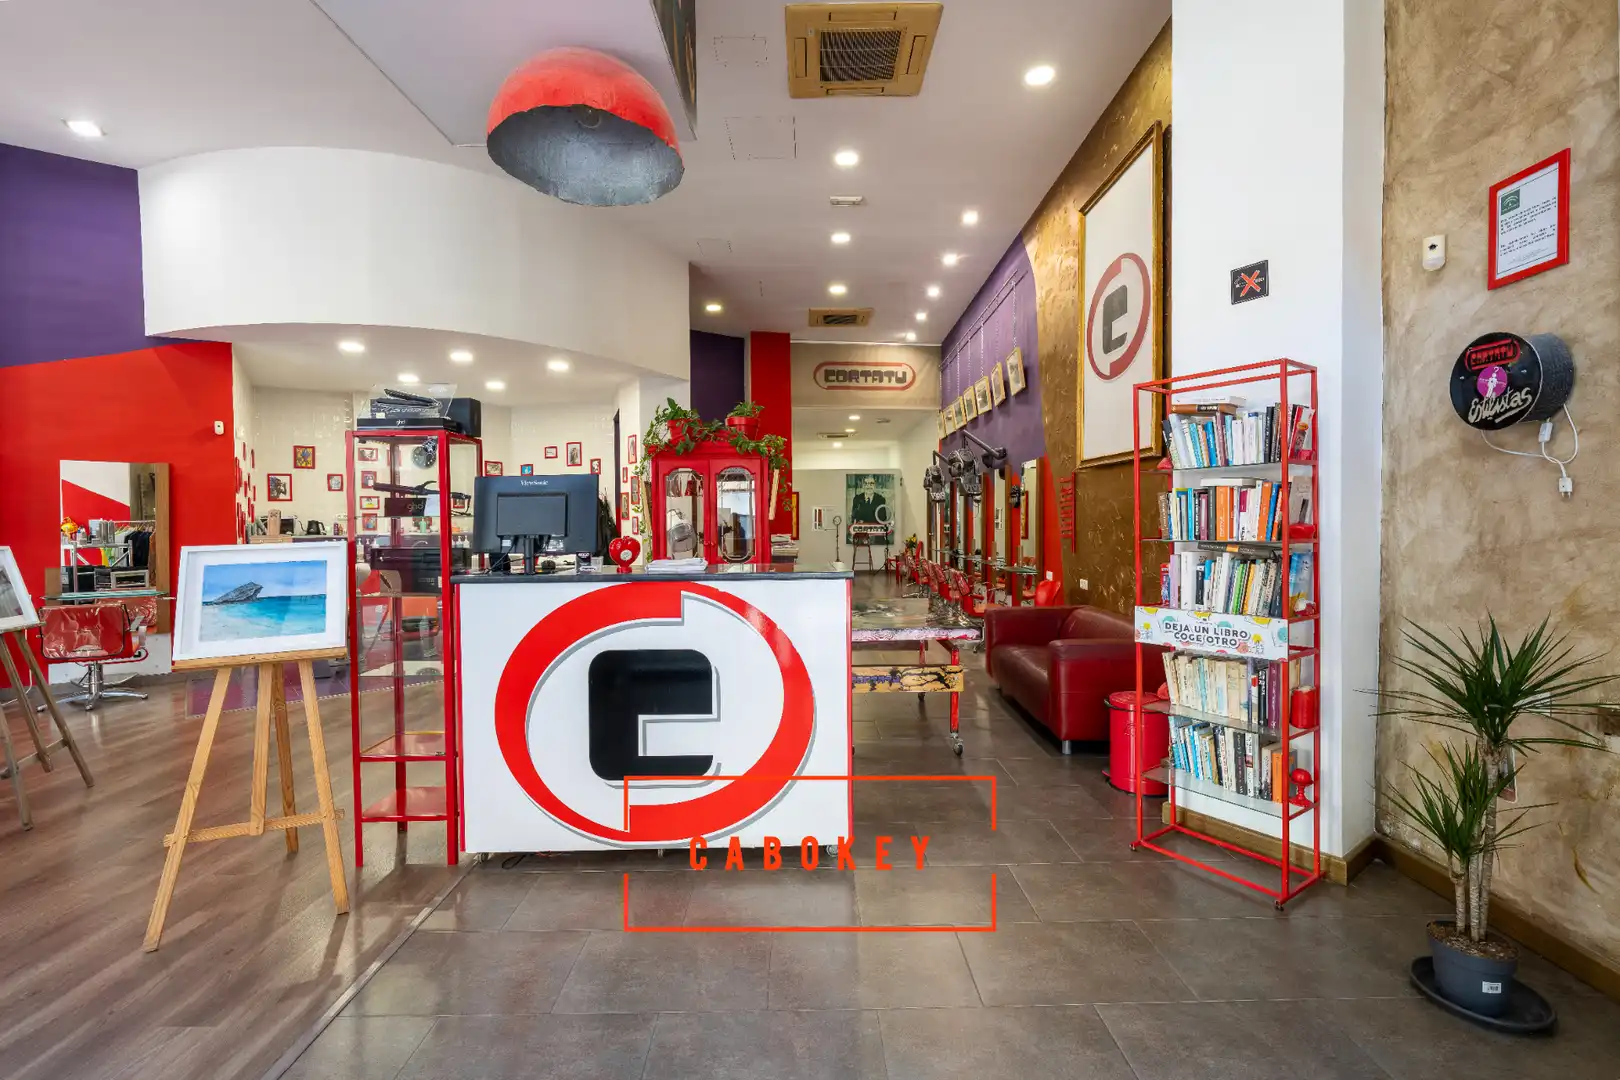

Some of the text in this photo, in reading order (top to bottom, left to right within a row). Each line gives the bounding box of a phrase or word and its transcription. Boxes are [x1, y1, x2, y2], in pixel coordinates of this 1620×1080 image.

[824, 369, 907, 383] CORTATU
[407, 500, 424, 512] ghd
[1165, 622, 1248, 638] DEJA UN LIBRO
[1174, 632, 1237, 646] COGE OTRO
